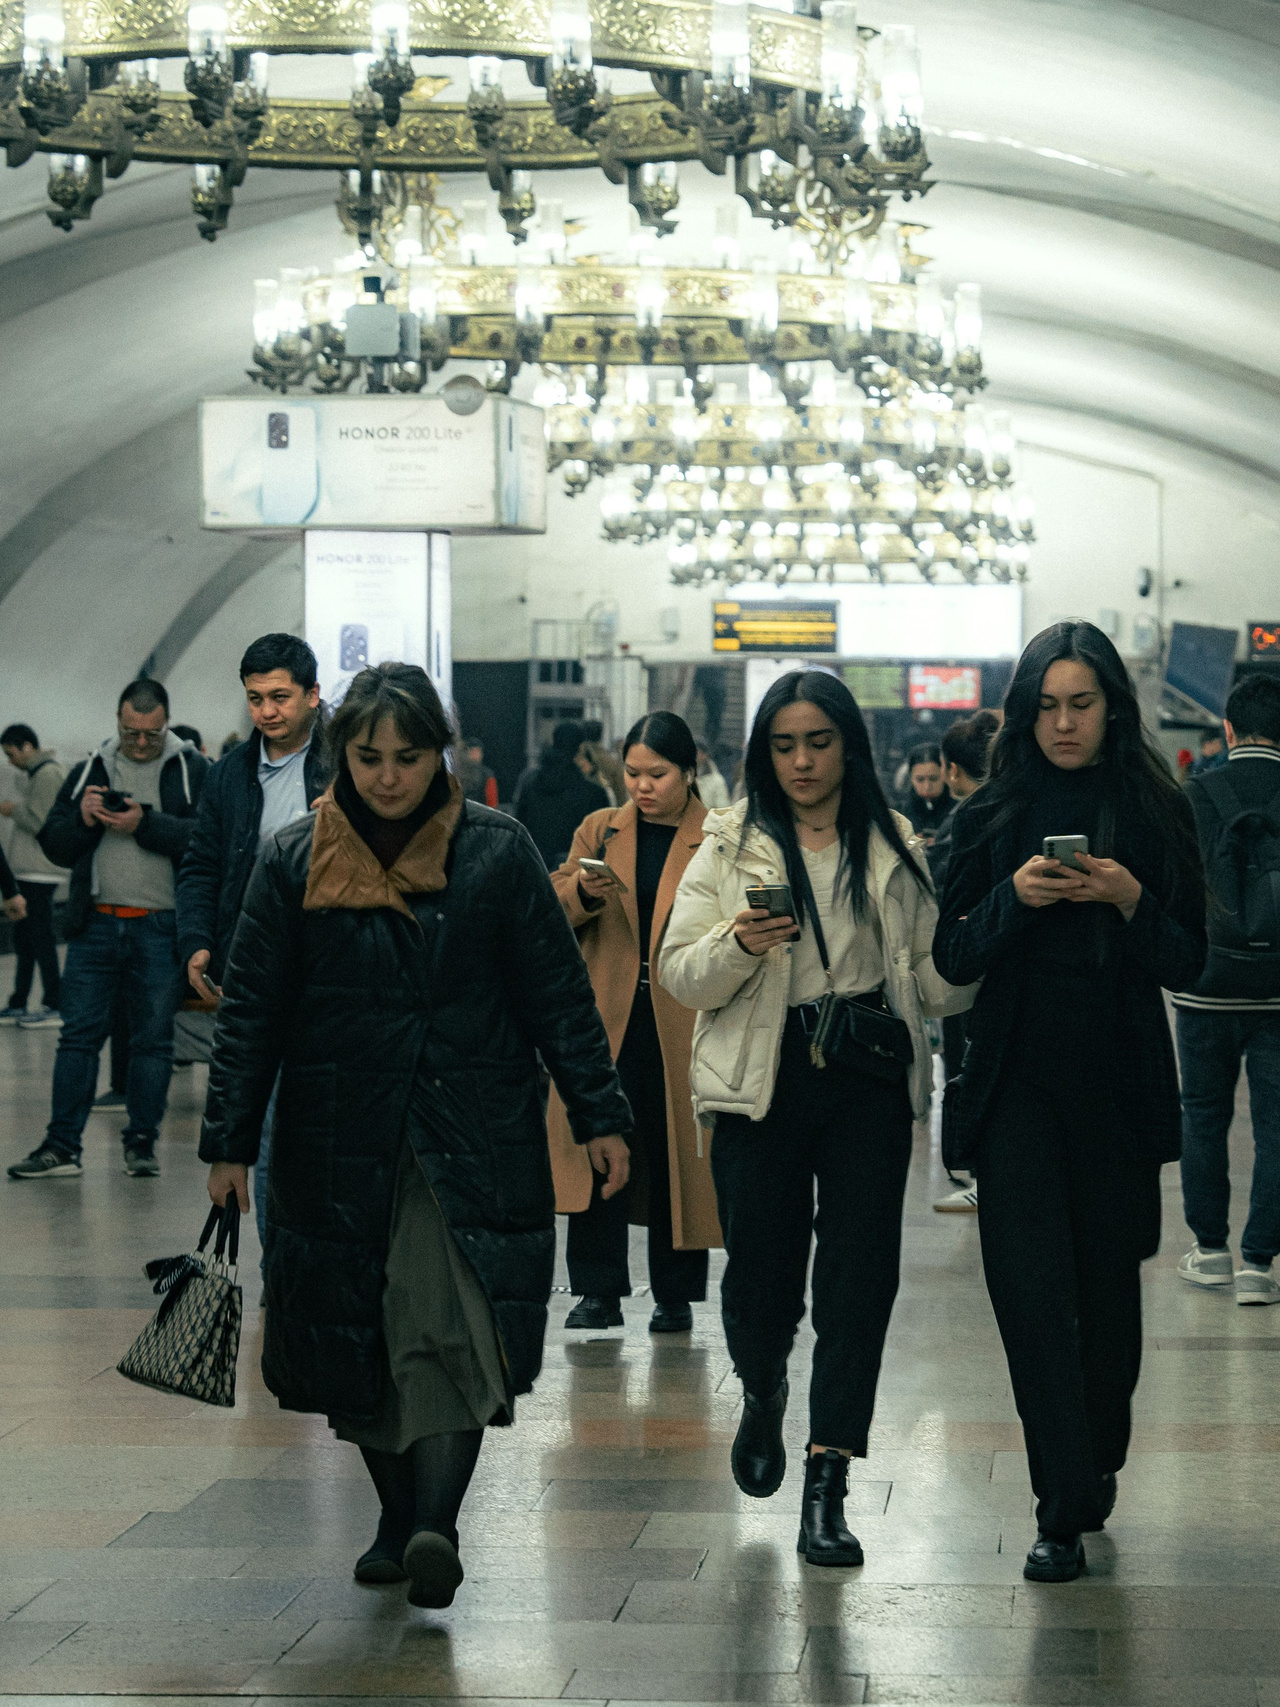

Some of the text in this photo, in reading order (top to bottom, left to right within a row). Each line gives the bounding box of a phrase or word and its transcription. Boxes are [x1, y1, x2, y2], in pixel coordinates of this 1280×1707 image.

[338, 426, 400, 440] HONOR
[405, 426, 431, 440] 200
[434, 426, 463, 440] Lite
[316, 553, 363, 564] HONOR
[367, 553, 387, 565] 200
